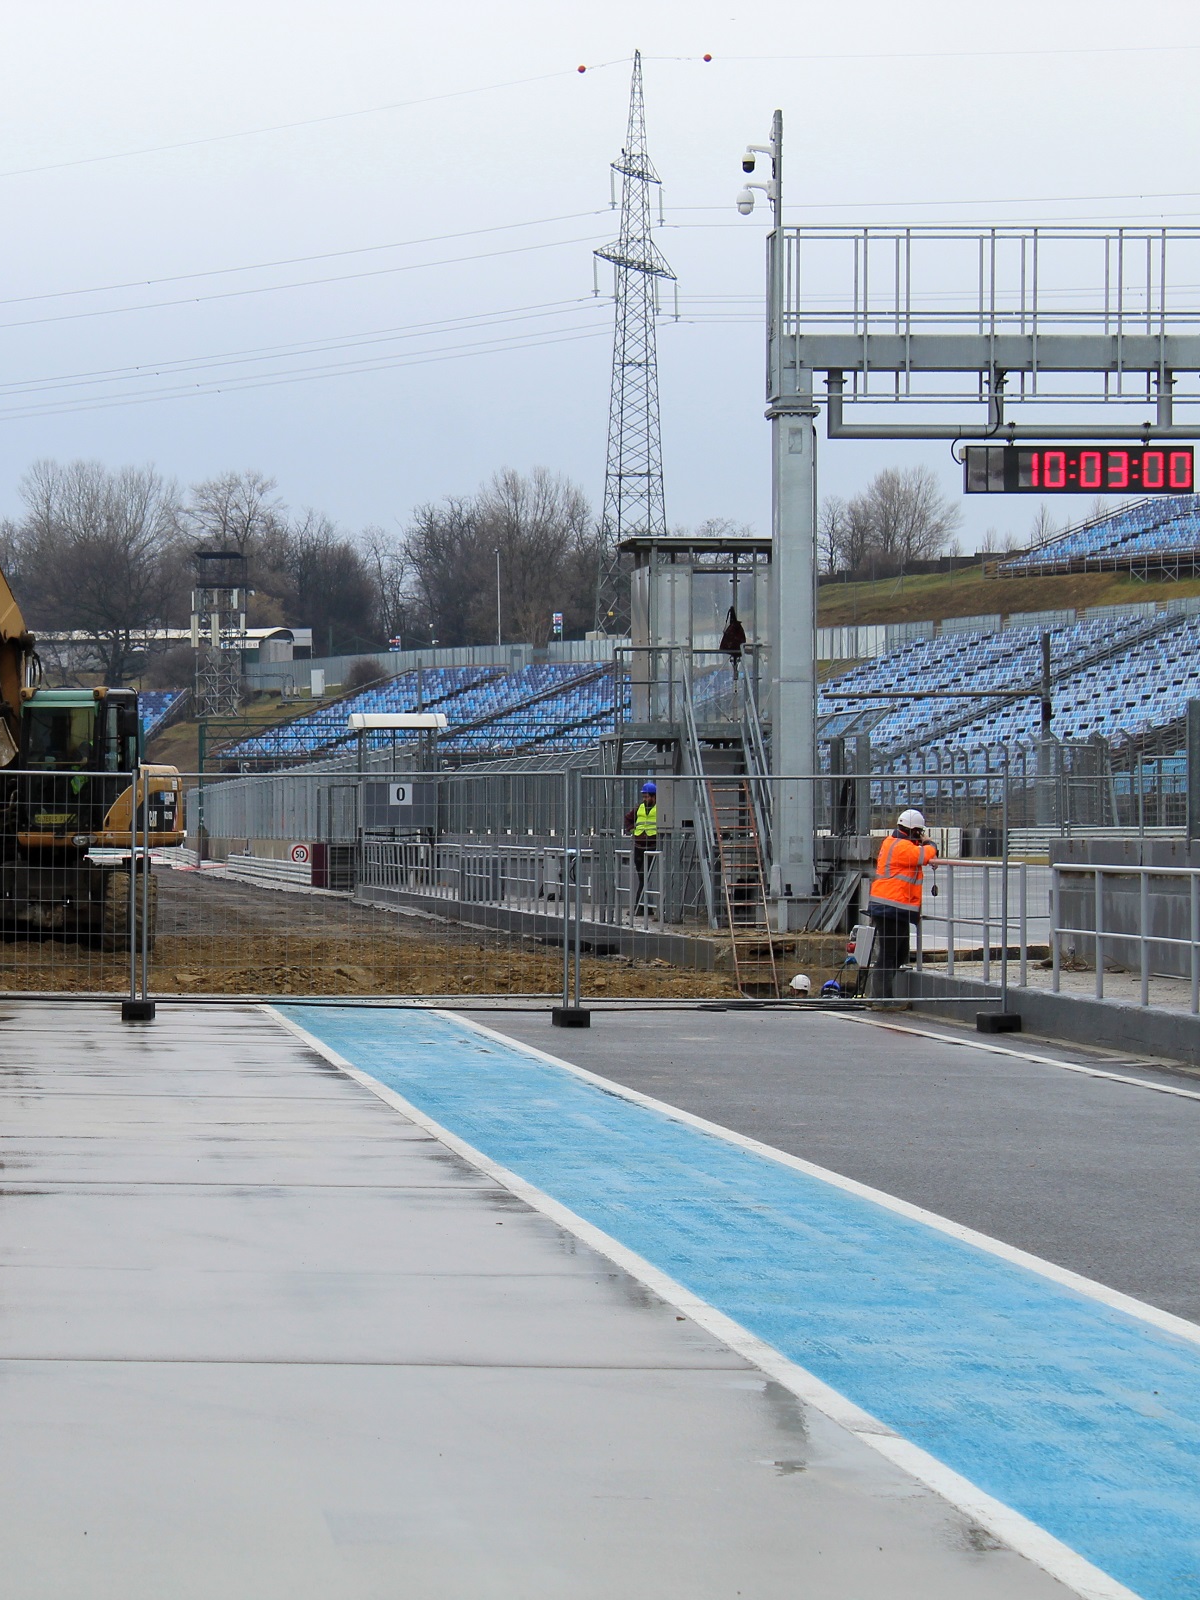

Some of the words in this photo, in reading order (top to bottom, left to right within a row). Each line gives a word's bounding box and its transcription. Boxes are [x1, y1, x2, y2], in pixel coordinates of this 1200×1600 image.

[1031, 452, 1191, 488] 10:03:00
[396, 787, 406, 801] 0
[148, 811, 157, 827] CAT
[295, 850, 304, 859] 50
